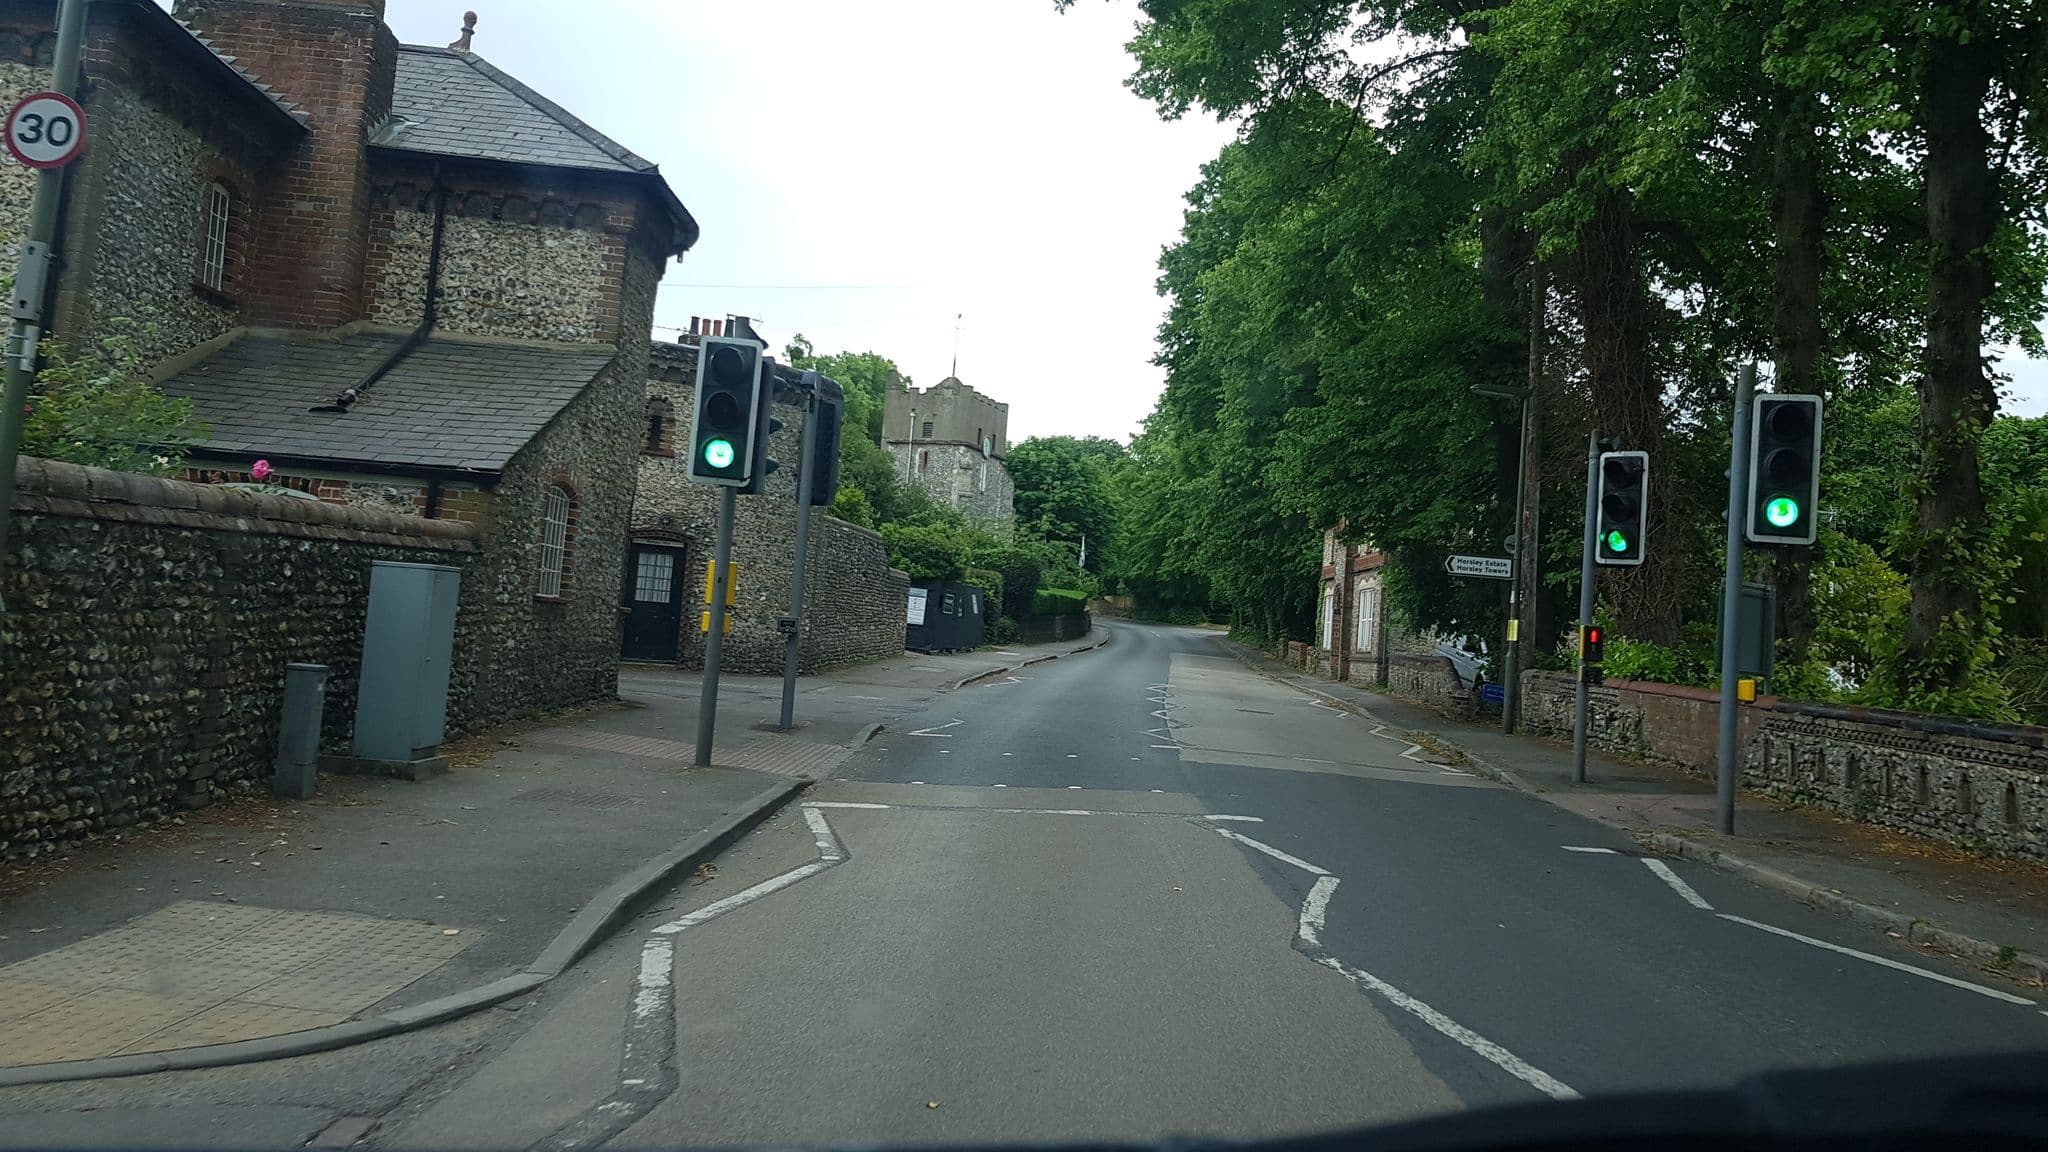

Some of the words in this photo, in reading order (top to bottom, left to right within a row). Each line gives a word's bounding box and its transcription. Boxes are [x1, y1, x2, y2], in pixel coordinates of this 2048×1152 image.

[18, 113, 72, 147] 30
[1457, 558, 1483, 566] Horsley
[1456, 565, 1482, 573] Horsley
